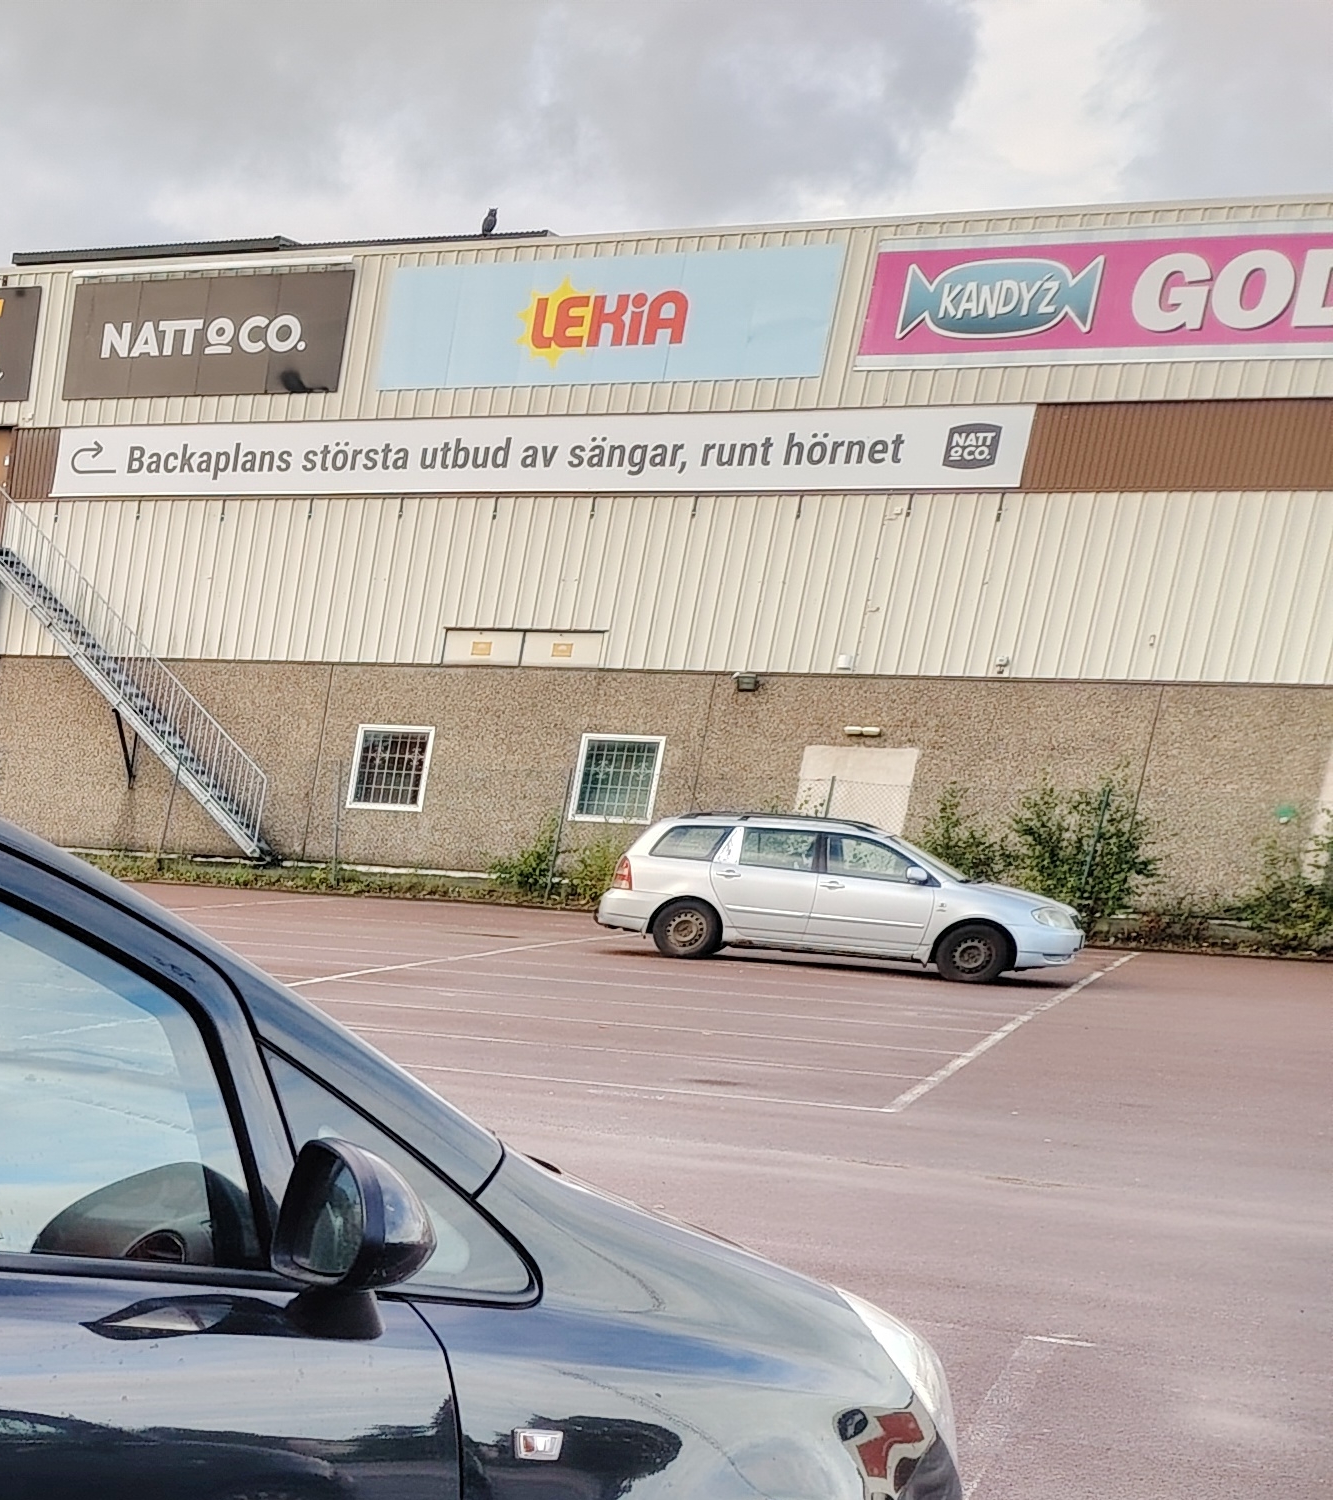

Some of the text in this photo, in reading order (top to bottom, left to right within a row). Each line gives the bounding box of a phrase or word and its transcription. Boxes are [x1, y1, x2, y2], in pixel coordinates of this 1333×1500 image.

[951, 431, 997, 447] NATT
[126, 432, 905, 481] Backaplans största utbud av sängar, runt hörnet
